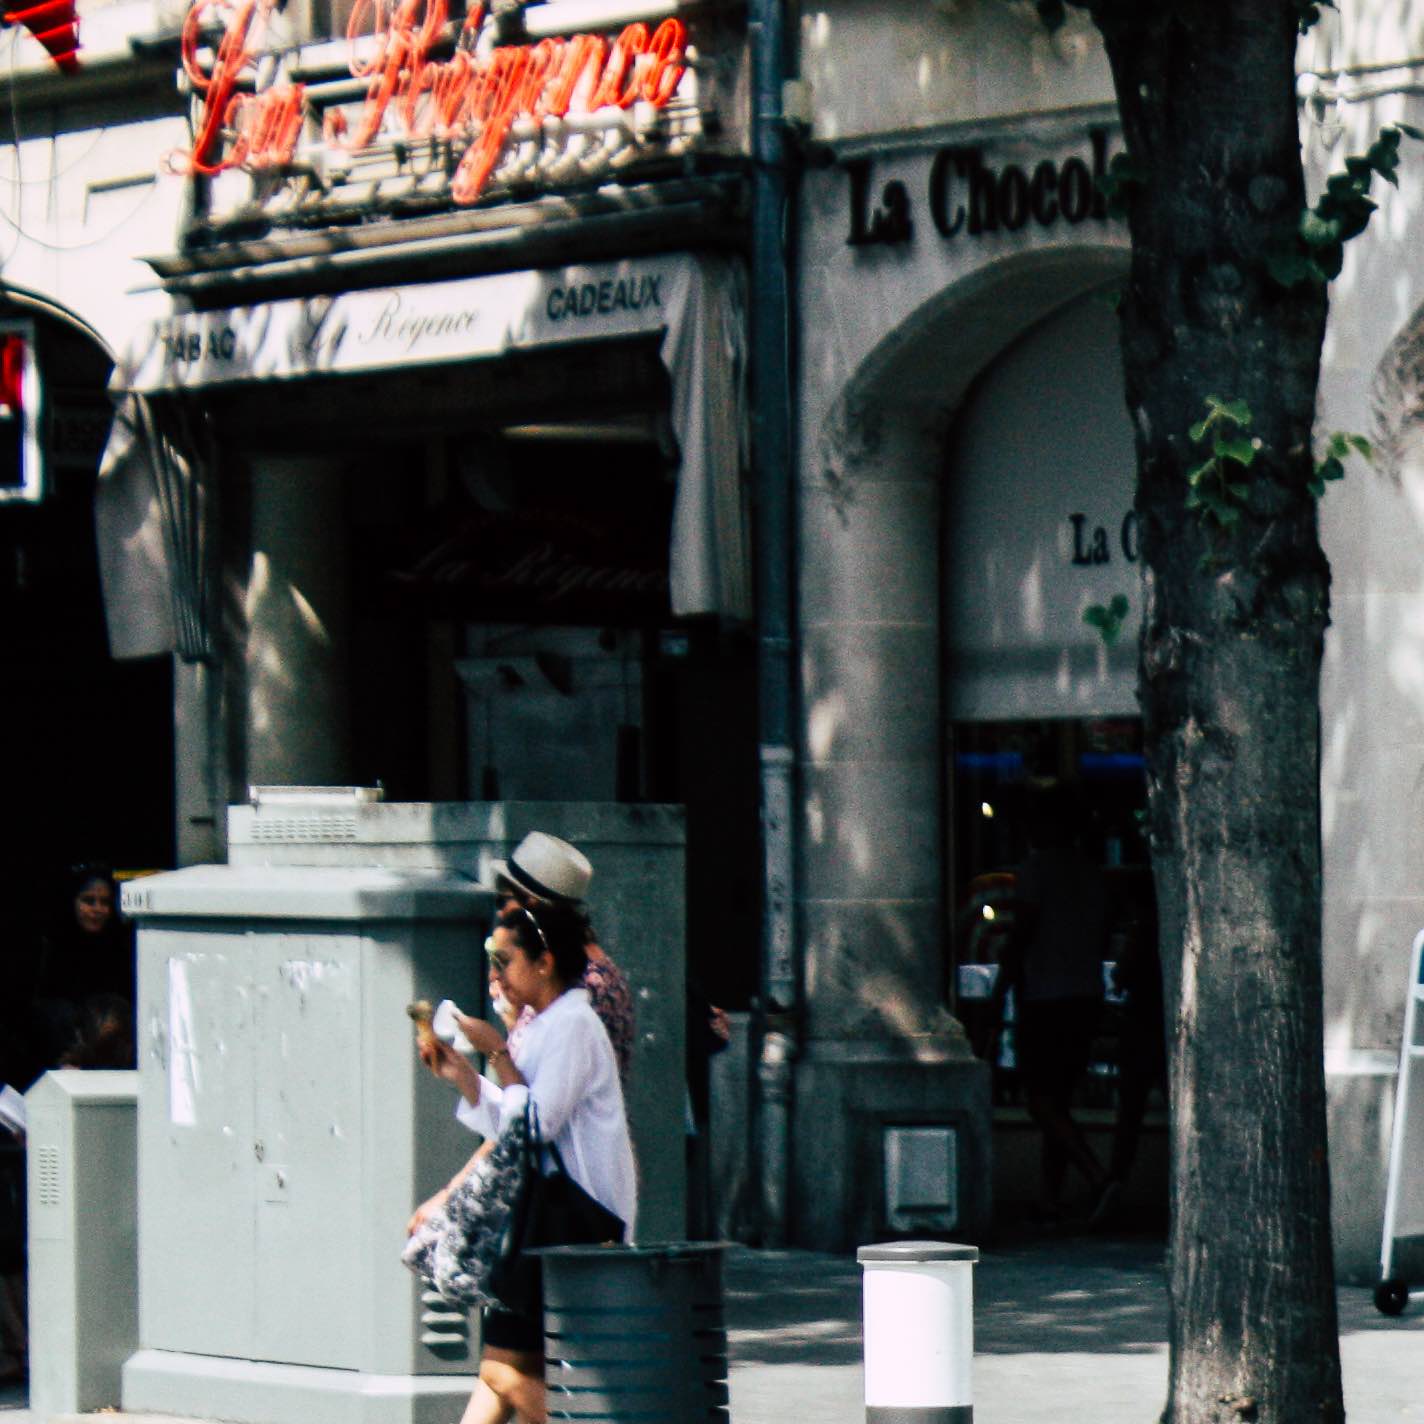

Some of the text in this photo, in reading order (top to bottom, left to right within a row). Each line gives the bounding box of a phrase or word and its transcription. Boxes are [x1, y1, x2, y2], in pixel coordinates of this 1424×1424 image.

[846, 125, 1110, 246] La Chocol
[546, 274, 664, 321] CADEAUX
[1069, 511, 1110, 566] La
